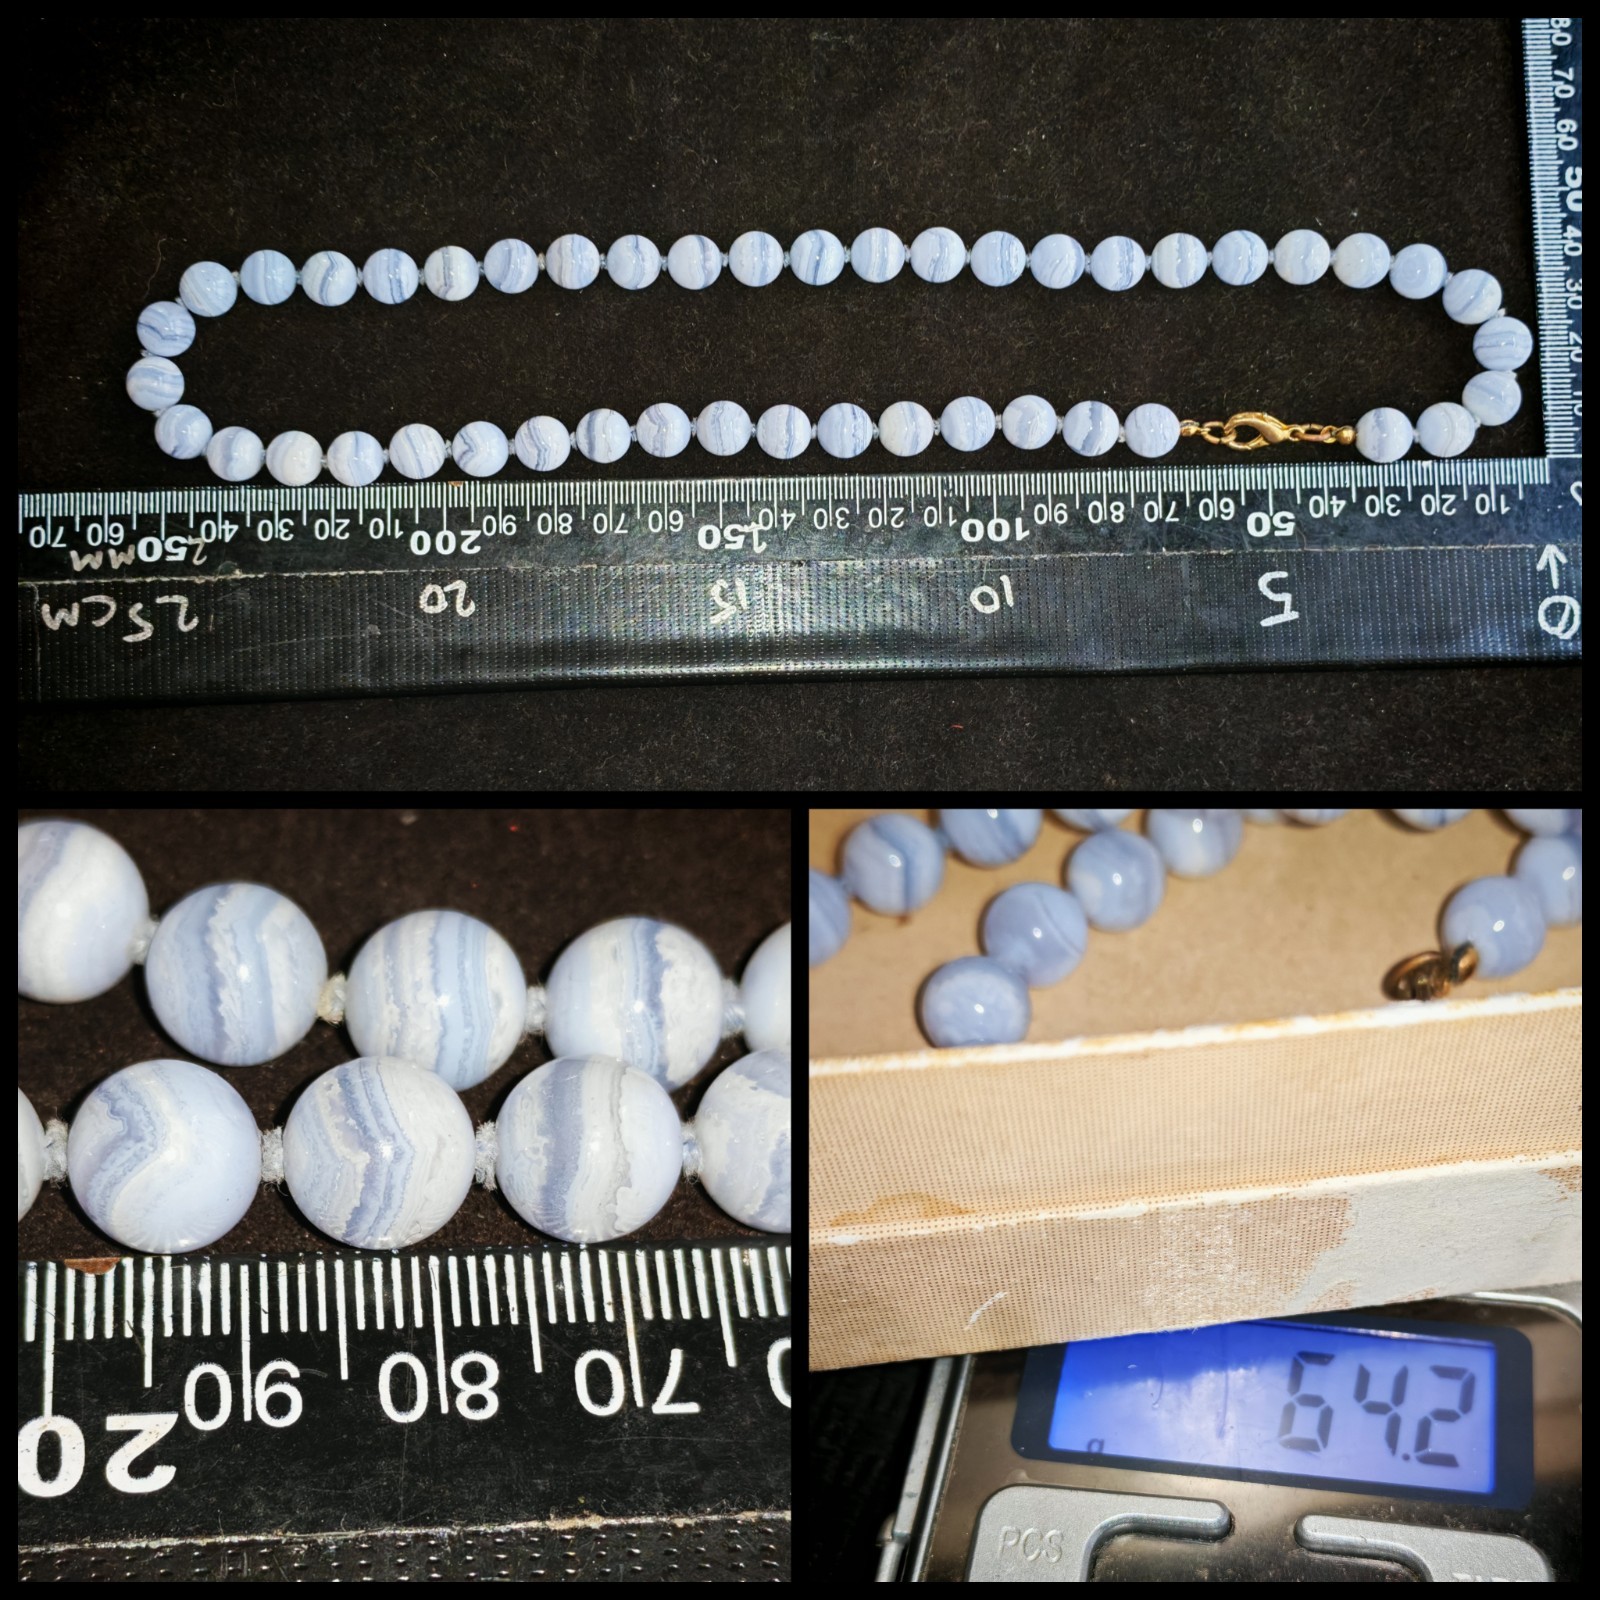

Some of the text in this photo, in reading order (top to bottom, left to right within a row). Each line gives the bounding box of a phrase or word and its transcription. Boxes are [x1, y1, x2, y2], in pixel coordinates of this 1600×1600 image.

[1550, 18, 1572, 46] 80
[1554, 67, 1576, 99] 70
[1556, 119, 1578, 151] 60
[1563, 225, 1582, 257] 40
[924, 505, 958, 527] 10
[1034, 502, 1068, 525] 90
[1088, 500, 1125, 524] 80
[1144, 500, 1180, 523] 70
[1199, 497, 1235, 521] 60
[1309, 495, 1346, 518] 40
[1365, 494, 1401, 517] 30
[1421, 493, 1457, 515] 20
[1476, 493, 1511, 515] 10
[482, 514, 517, 536] 90
[537, 512, 573, 535] 80
[593, 512, 629, 534] 70
[648, 509, 684, 533] 60
[759, 508, 796, 529] 40
[813, 507, 850, 529] 30
[868, 506, 904, 528] 20
[1247, 511, 1296, 537] 50
[29, 525, 67, 548] 70
[86, 522, 125, 546] 60
[200, 519, 239, 543] 40
[257, 518, 294, 542] 30
[314, 518, 350, 541] 20
[369, 518, 402, 541] 10
[961, 517, 1030, 543] 100
[410, 529, 482, 556] 200
[418, 579, 477, 618] 20
[710, 578, 748, 625] 15
[969, 573, 1015, 615] 10
[1257, 570, 1300, 627] 5
[379, 1350, 500, 1424] 80
[574, 1347, 700, 1417] 70
[184, 1358, 304, 1431] 90
[1278, 1350, 1476, 1468] 64.2
[999, 1525, 1064, 1563] PCS
